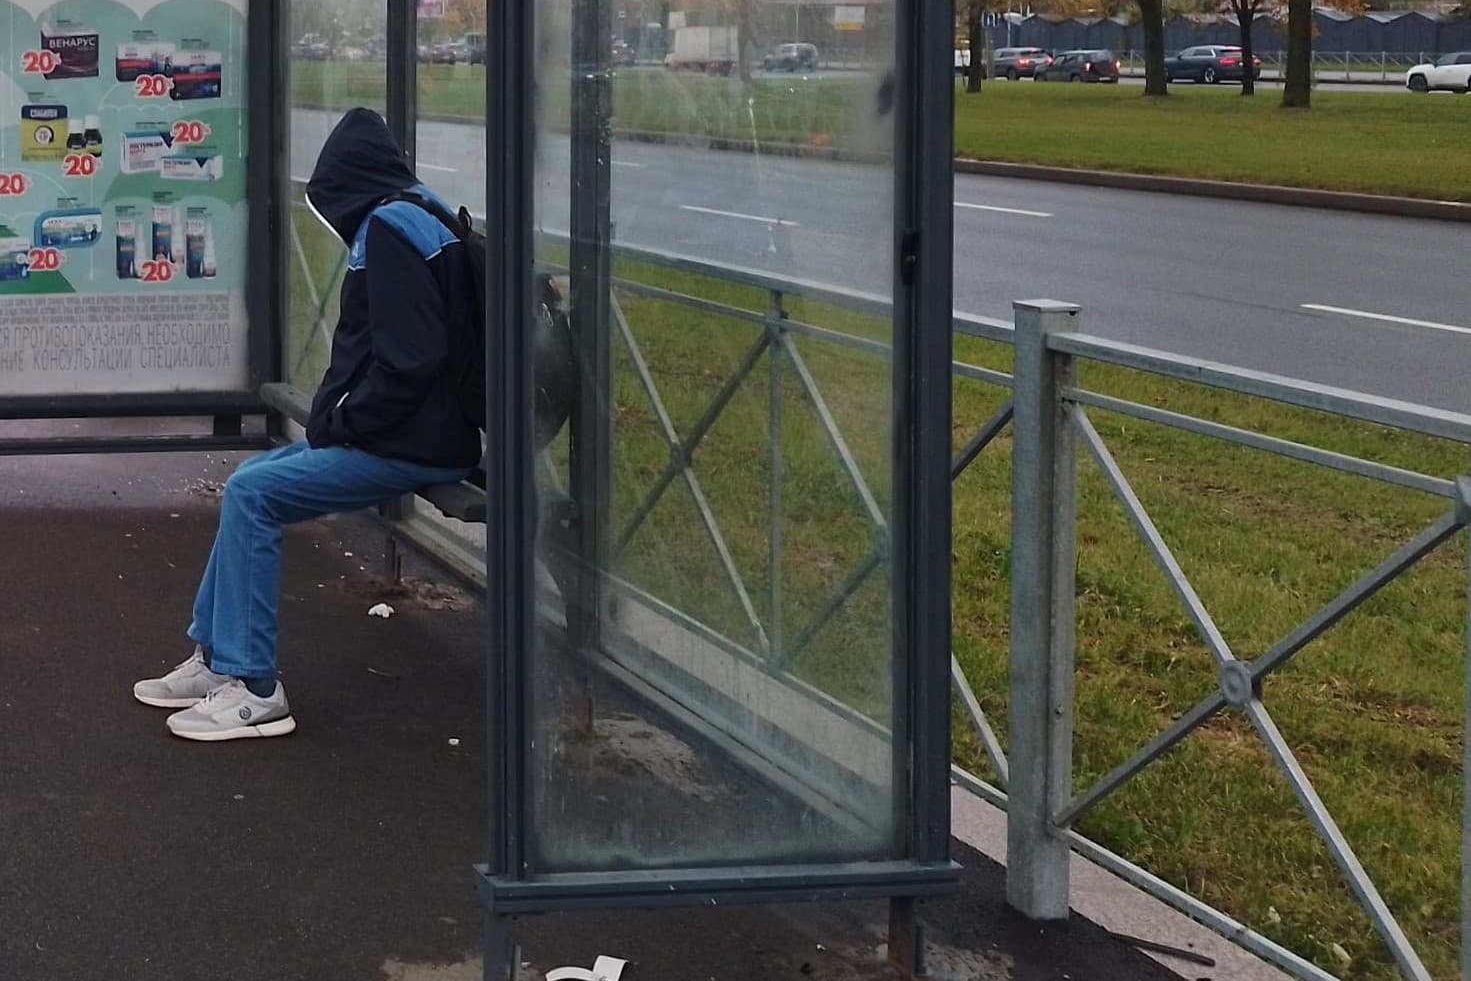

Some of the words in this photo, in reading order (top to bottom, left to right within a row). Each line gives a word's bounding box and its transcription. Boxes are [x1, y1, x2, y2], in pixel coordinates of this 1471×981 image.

[49, 37, 96, 49] ВЕНАРУС
[31, 346, 133, 371] КОНСУЛЬТАЦИИ
[140, 345, 231, 371] СПЕЦИАЛИСТА
